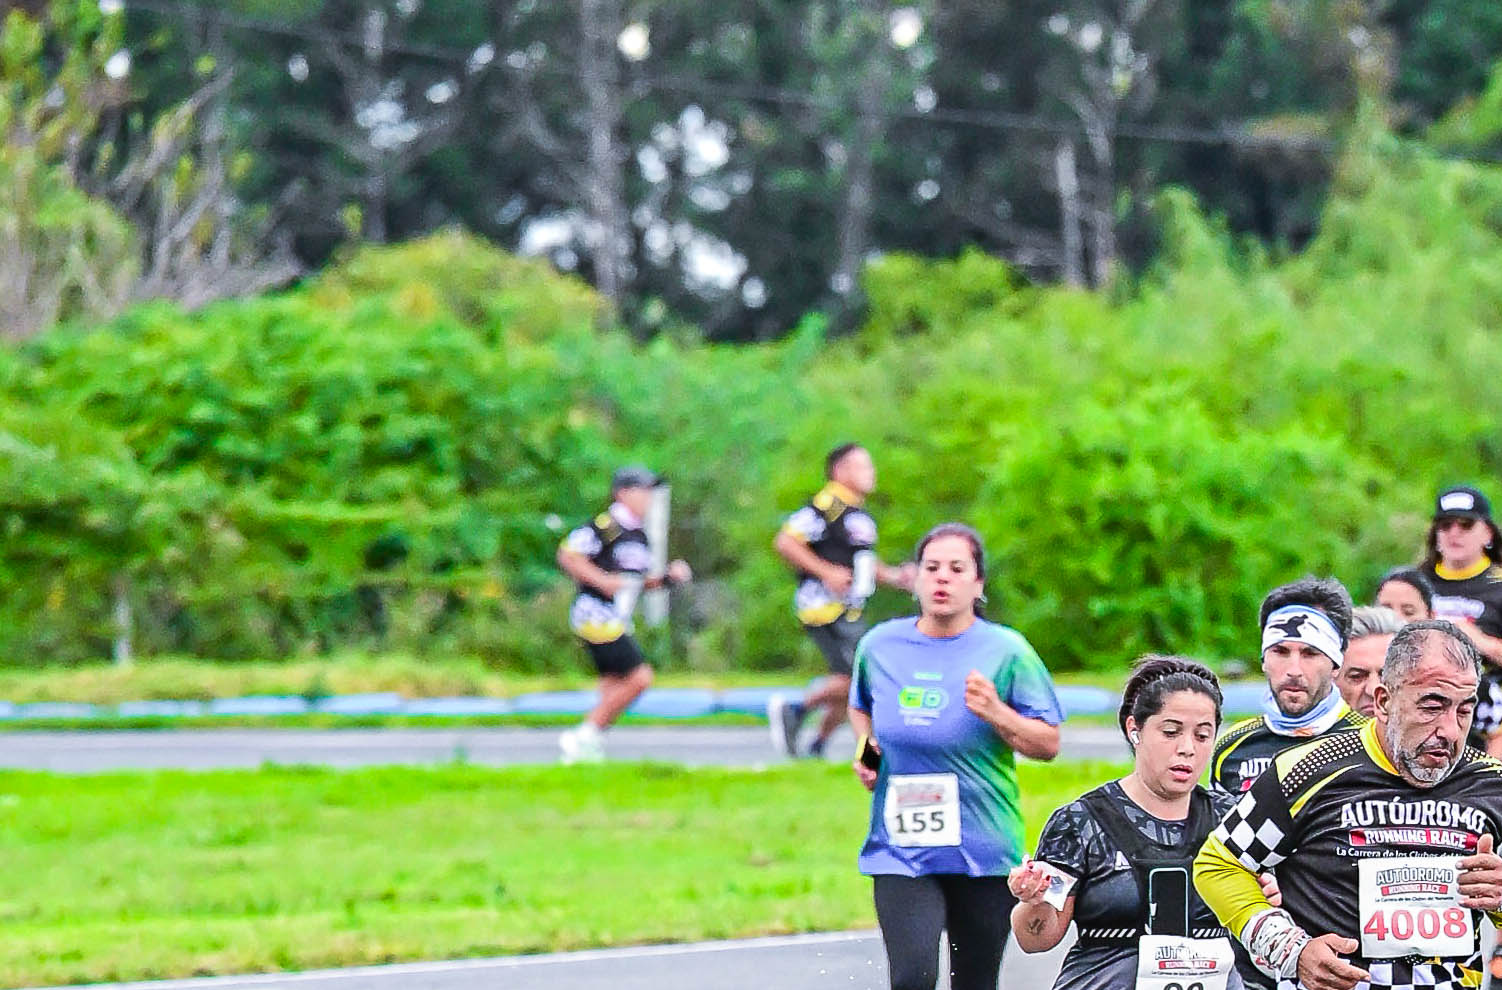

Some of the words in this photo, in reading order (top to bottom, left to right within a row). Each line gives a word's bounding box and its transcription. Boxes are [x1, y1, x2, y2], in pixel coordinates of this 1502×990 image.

[896, 811, 944, 833] 155
[1341, 796, 1487, 834] AUTÓDROMO
[1364, 829, 1427, 844] RUNNING
[1430, 829, 1467, 849] RACE
[1336, 846, 1346, 856] La
[1348, 848, 1380, 857] Carrera
[1376, 864, 1454, 886] AUTÓDROMO
[1364, 907, 1468, 941] 4008
